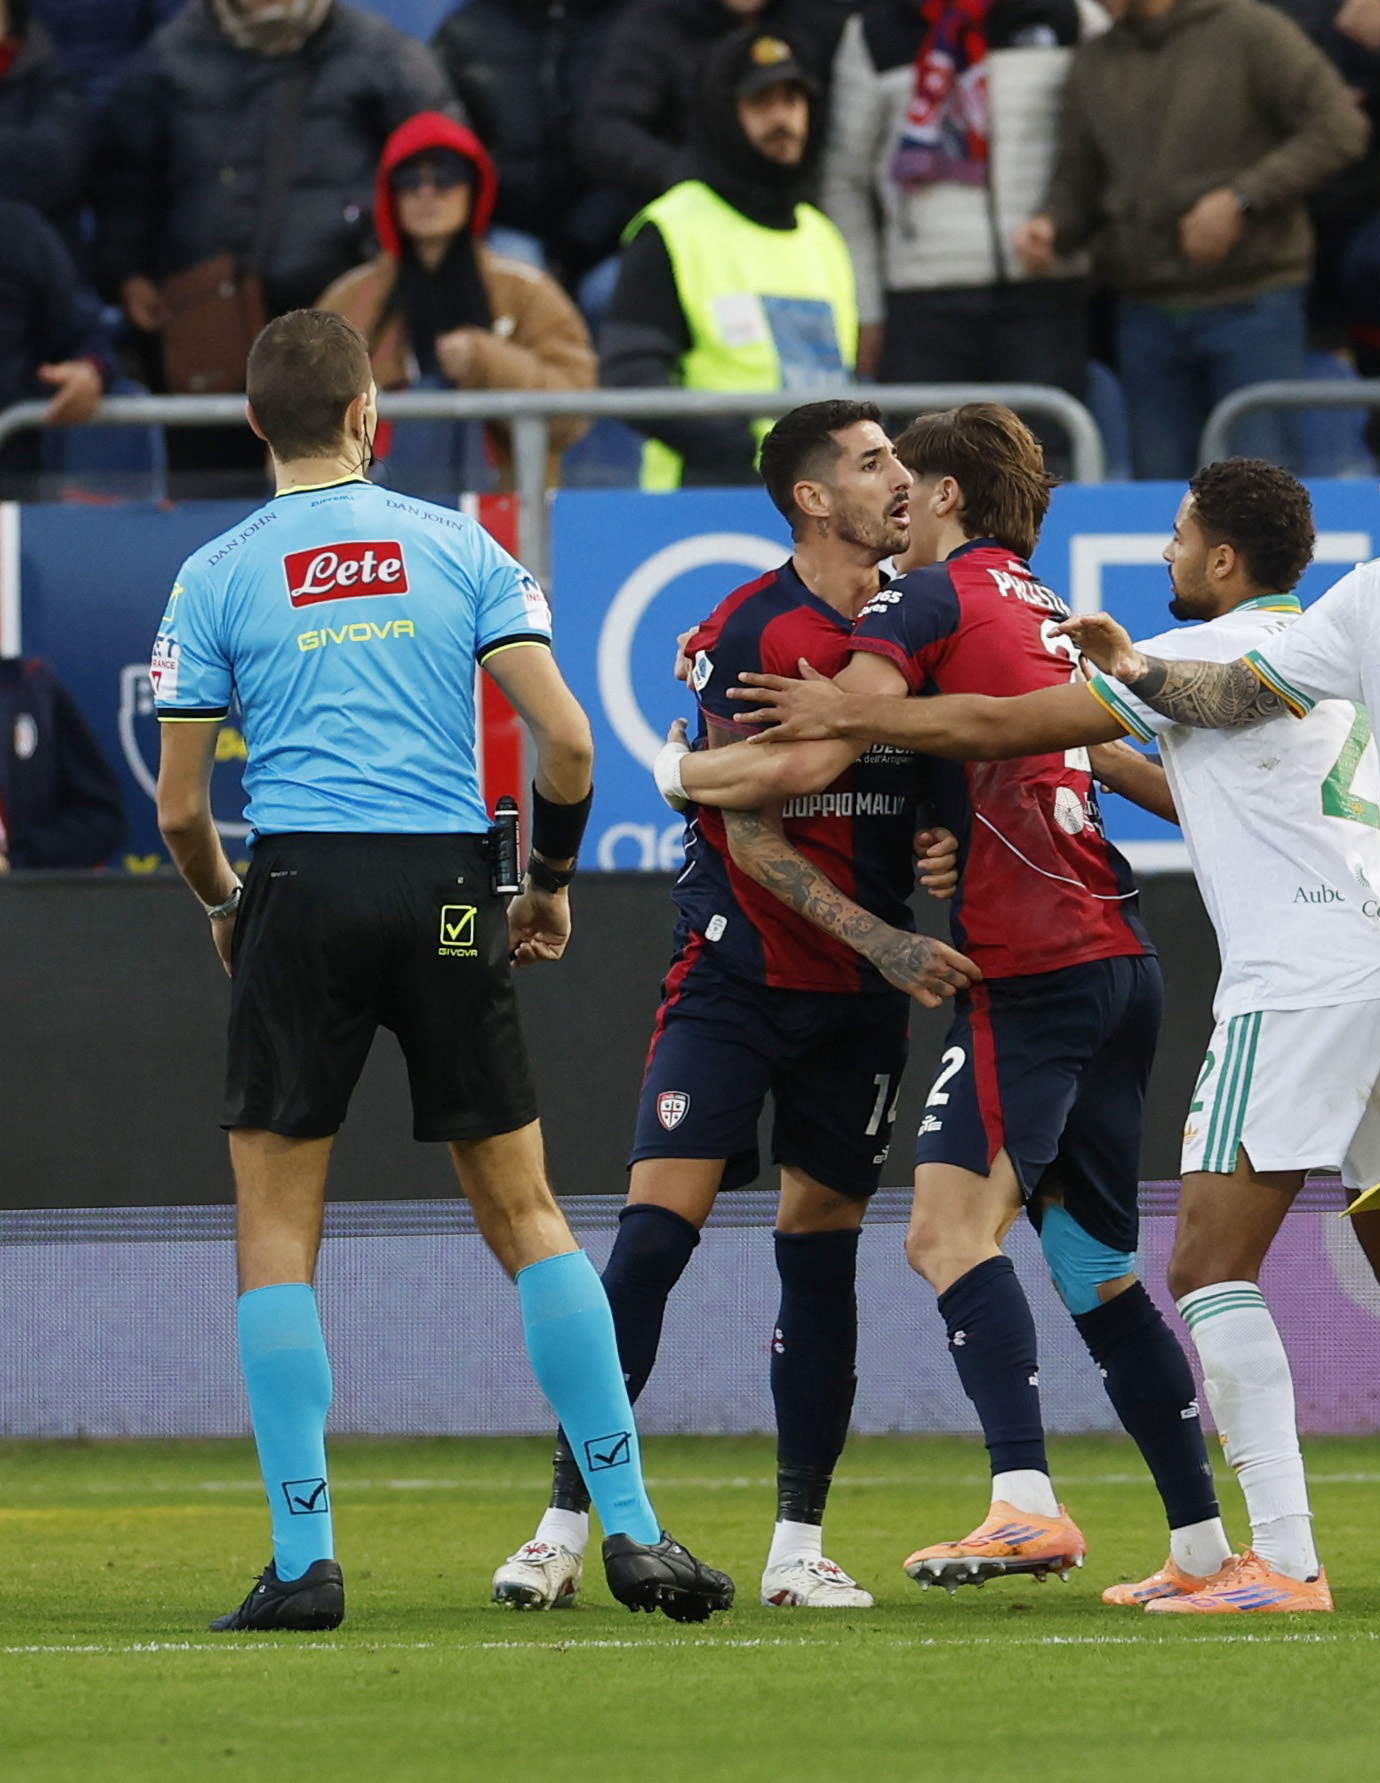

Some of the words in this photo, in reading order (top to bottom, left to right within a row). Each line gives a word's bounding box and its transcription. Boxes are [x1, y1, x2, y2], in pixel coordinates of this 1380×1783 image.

[385, 499, 415, 516] DAN
[420, 512, 465, 532] JOHN
[207, 539, 240, 567] DAN
[238, 511, 278, 546] JOHN
[290, 551, 402, 598] Lete
[297, 619, 415, 652] GIVOVA
[438, 947, 478, 957] GIVOVA
[925, 1045, 966, 1108] 2
